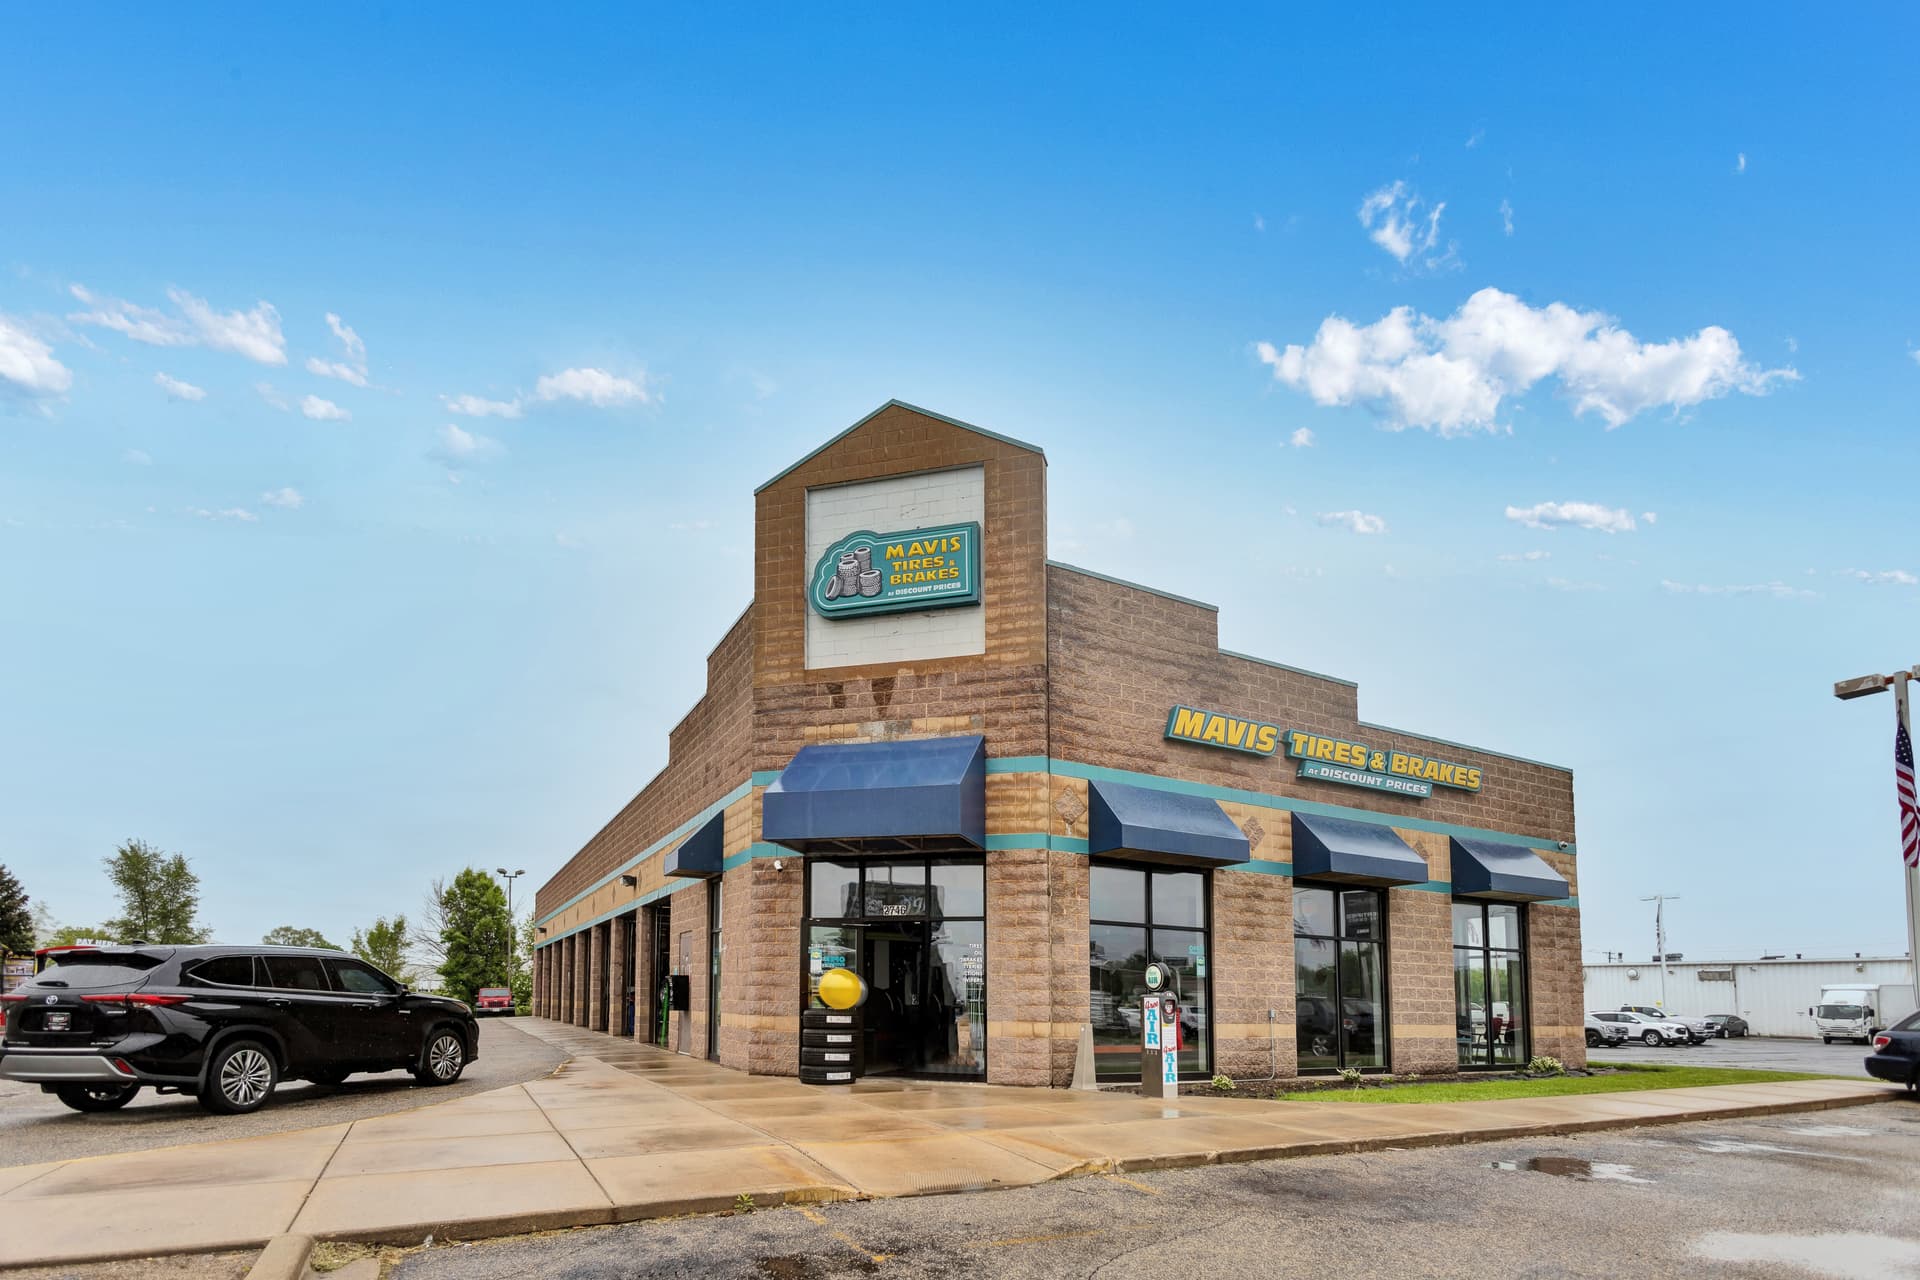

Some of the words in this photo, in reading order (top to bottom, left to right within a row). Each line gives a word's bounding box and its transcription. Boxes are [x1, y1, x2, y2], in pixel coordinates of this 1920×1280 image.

[885, 536, 961, 560] MAVIS
[890, 567, 959, 585] BRAKES
[892, 556, 944, 572] TIRES
[895, 585, 932, 595] DISCOUNT
[933, 582, 961, 590] PRICES
[1173, 708, 1278, 752] MAVIS
[1292, 733, 1367, 767] TIRES
[1370, 752, 1385, 770] &
[1391, 753, 1481, 789] BRAKES
[1319, 767, 1383, 786] DISCOUNT
[1386, 779, 1428, 794] PRICES
[1147, 1009, 1159, 1044] AIR
[1165, 1052, 1176, 1082] AIR
